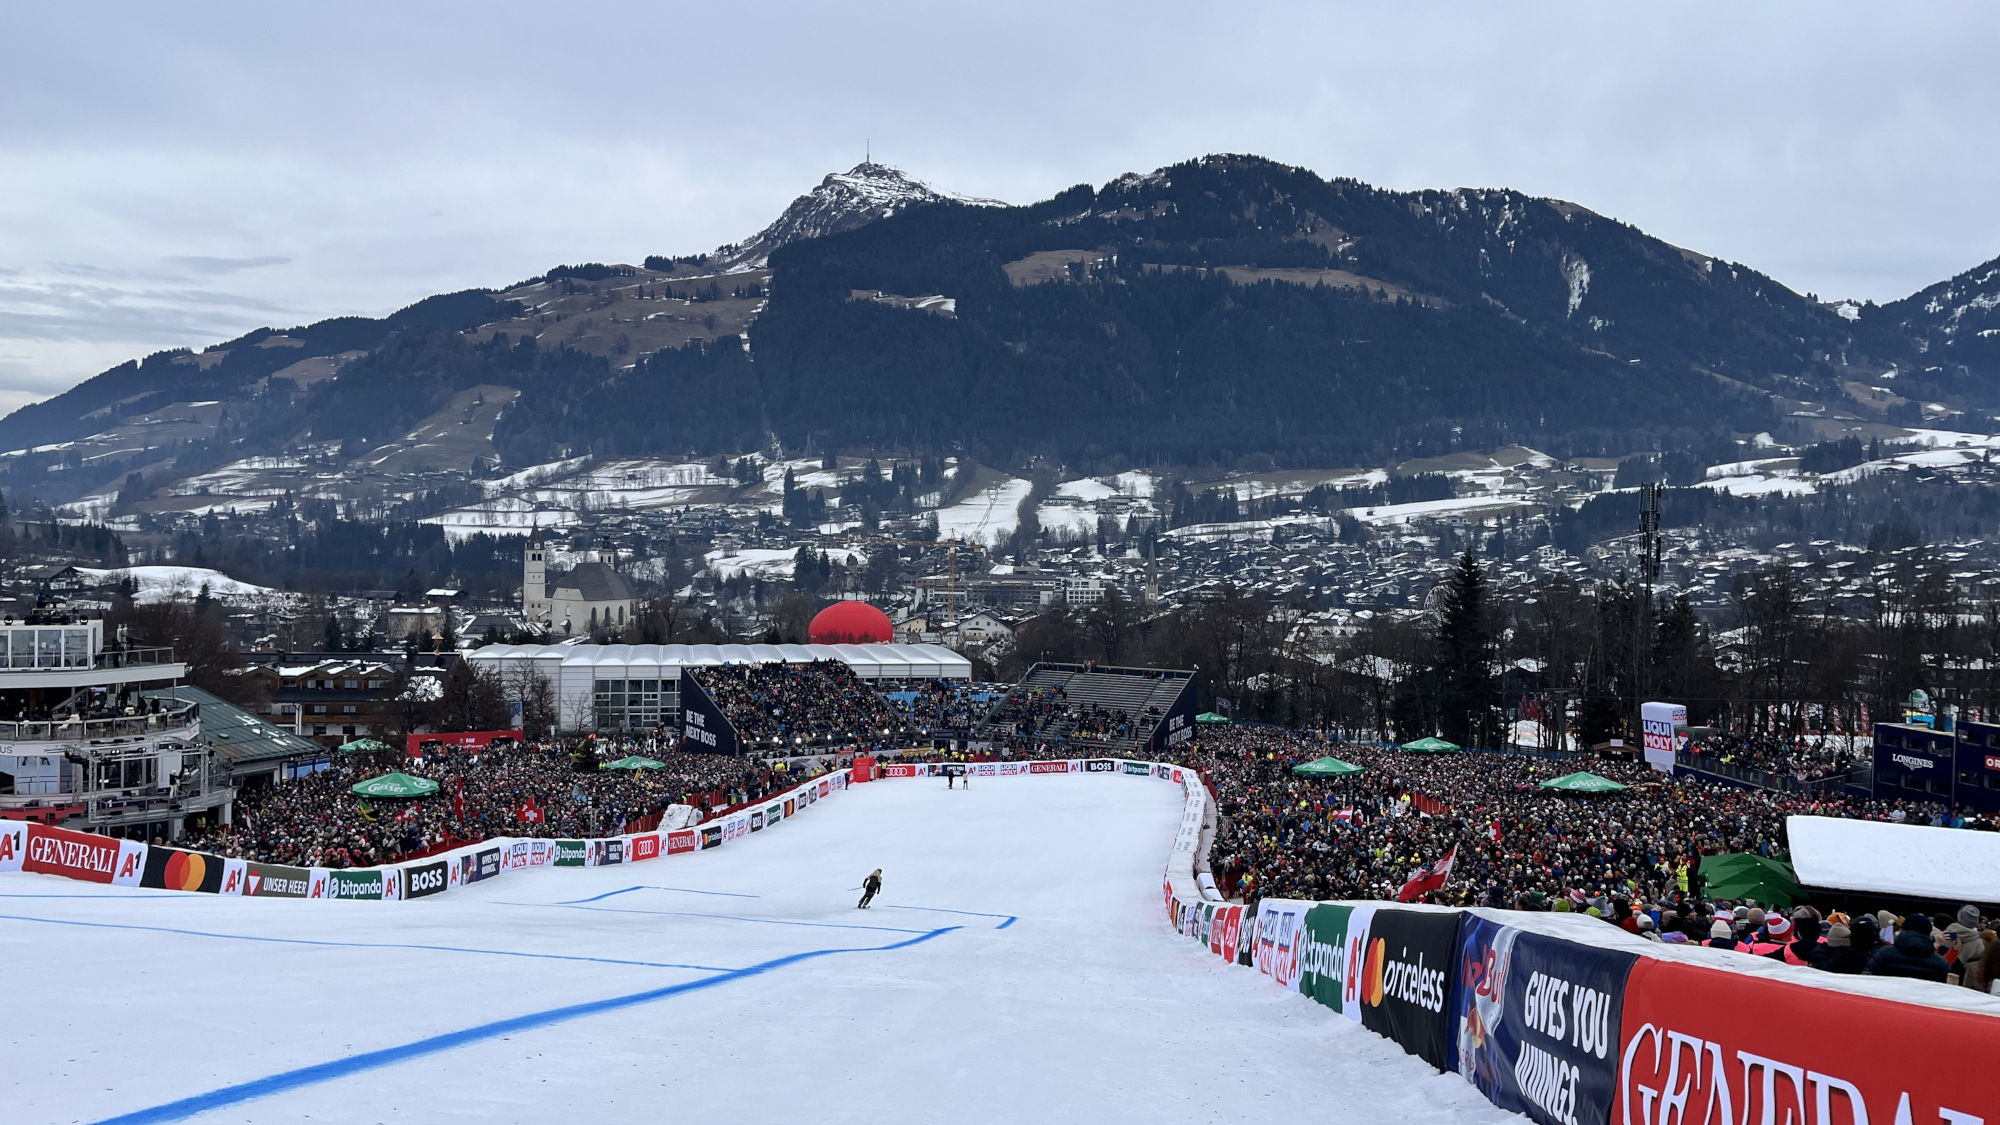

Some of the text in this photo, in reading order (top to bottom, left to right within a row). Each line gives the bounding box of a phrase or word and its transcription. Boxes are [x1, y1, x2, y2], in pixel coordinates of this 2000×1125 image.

[686, 709, 705, 727] BE THE
[685, 725, 717, 747] NEXT BOSS
[1180, 725, 1193, 741] BOSS
[1643, 720, 1671, 736] LIQUI
[1644, 734, 1671, 751] MOLY
[1030, 764, 1067, 773] GENERALI
[1090, 762, 1112, 771] BOSS
[1892, 753, 1934, 769] LONGINES
[0, 831, 21, 859] A1
[668, 835, 695, 850] GENERALI
[30, 836, 116, 873] GENERALI
[561, 846, 585, 861] bitpanda
[119, 851, 142, 878] A1
[225, 867, 242, 893] A1
[263, 876, 307, 894] UNSER HEER
[340, 879, 381, 898] bitpanda
[411, 868, 443, 892] BOSS
[1524, 970, 1611, 1060] GIVES YOU
